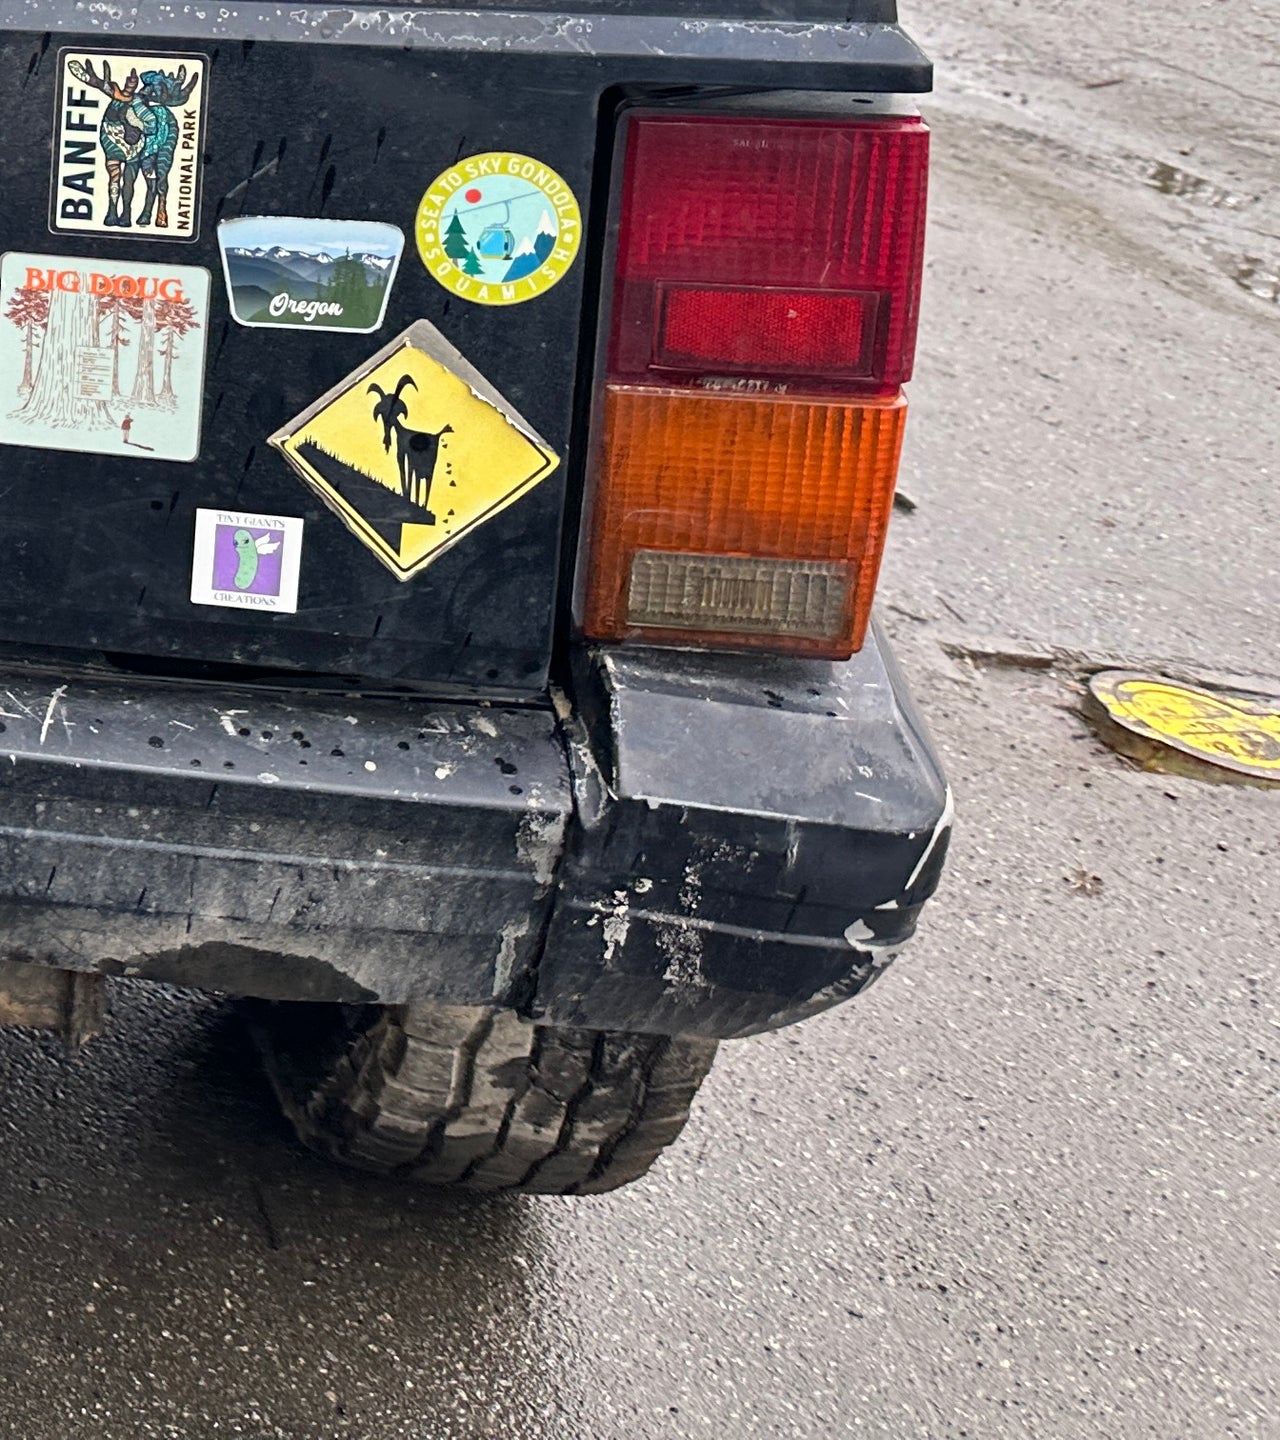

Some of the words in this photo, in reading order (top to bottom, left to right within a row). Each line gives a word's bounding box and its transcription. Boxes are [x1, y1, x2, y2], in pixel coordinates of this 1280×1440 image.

[182, 109, 197, 150] PARK
[60, 86, 99, 221] BANFF
[177, 154, 194, 230] NATIONAL
[421, 192, 446, 230] SEA
[440, 173, 462, 193] TO
[464, 157, 502, 178] SKY
[507, 157, 577, 230] GONDOLA
[24, 267, 81, 294] BIG
[88, 272, 185, 303] DOUG
[424, 247, 570, 300] SQUAMISH
[269, 293, 343, 322] Oregon
[217, 514, 242, 525] TINY
[244, 516, 285, 528] GIANTS
[214, 592, 277, 606] CREATIONS
